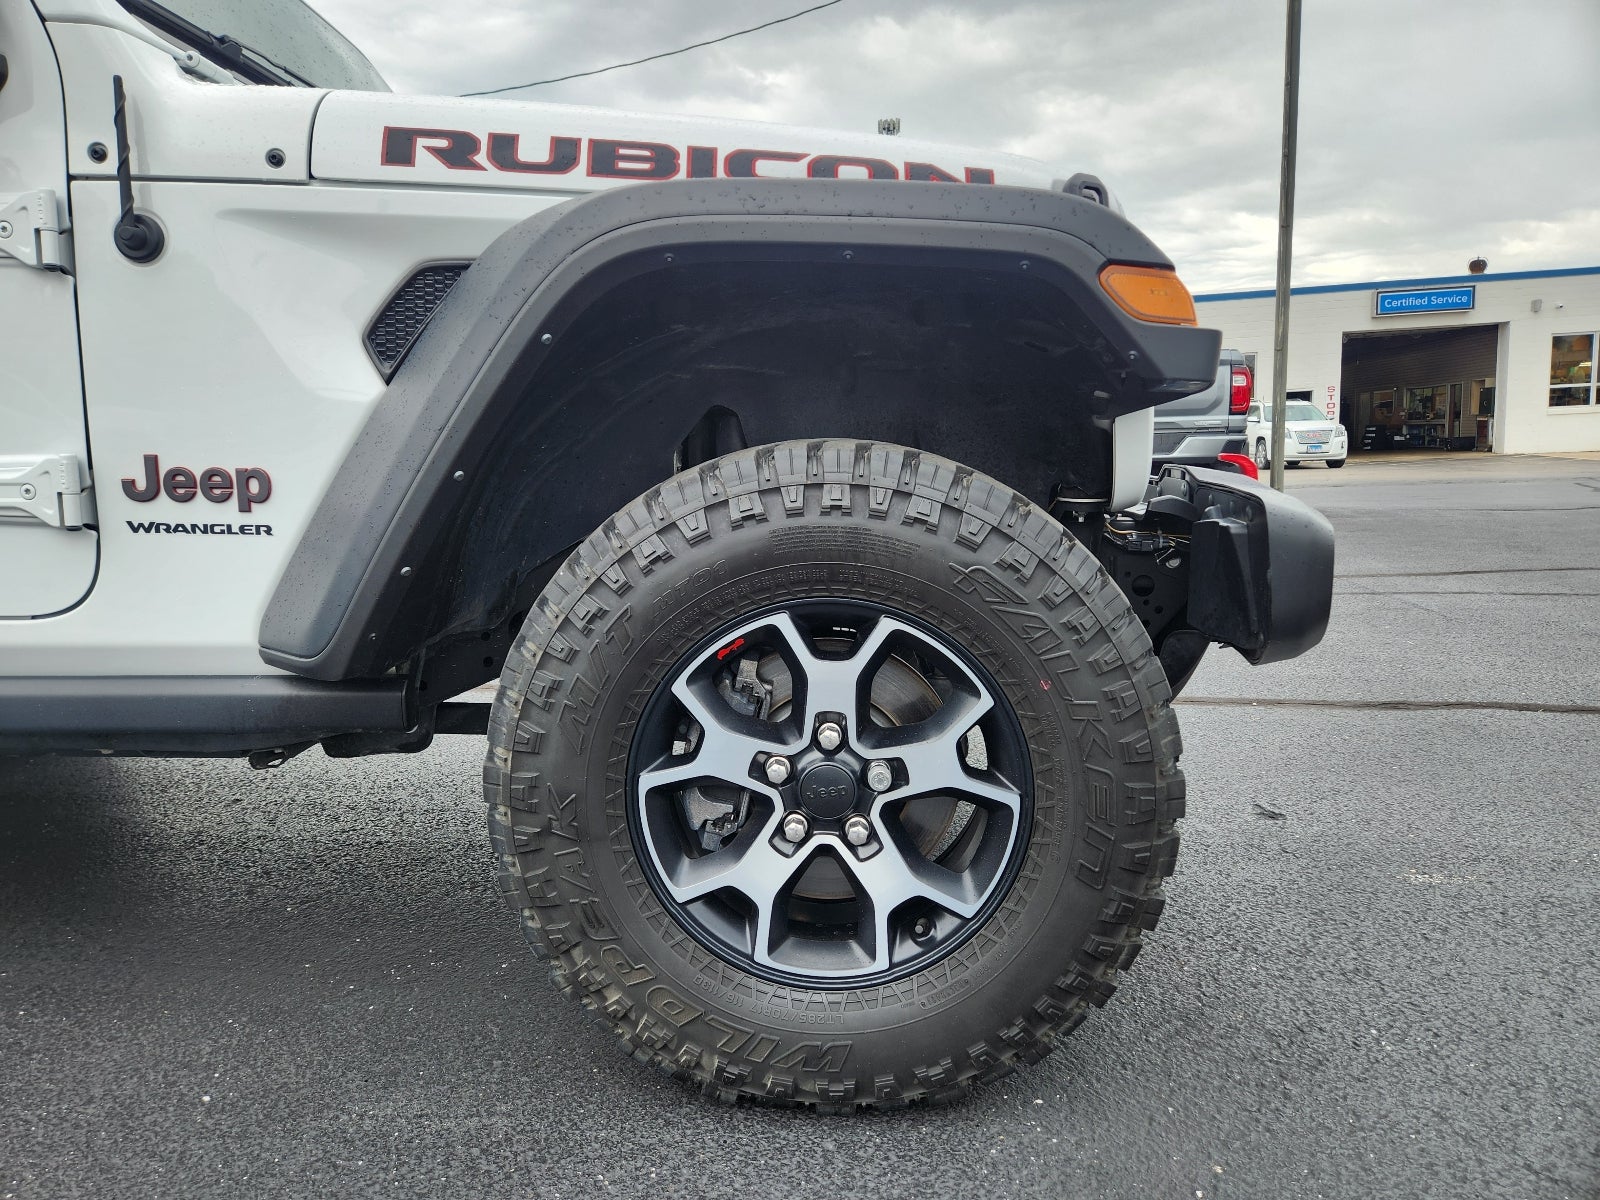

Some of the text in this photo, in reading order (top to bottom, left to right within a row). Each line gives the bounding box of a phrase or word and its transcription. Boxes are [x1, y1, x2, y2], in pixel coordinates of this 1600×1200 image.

[380, 126, 995, 184] RUBICON
[1384, 294, 1468, 308] Certified Service
[120, 454, 272, 513] Jeep
[125, 520, 273, 537] WRANGLER
[948, 561, 1119, 890] FALKEN
[806, 784, 847, 799] Jeep
[547, 782, 853, 1073] WILDPEAK
